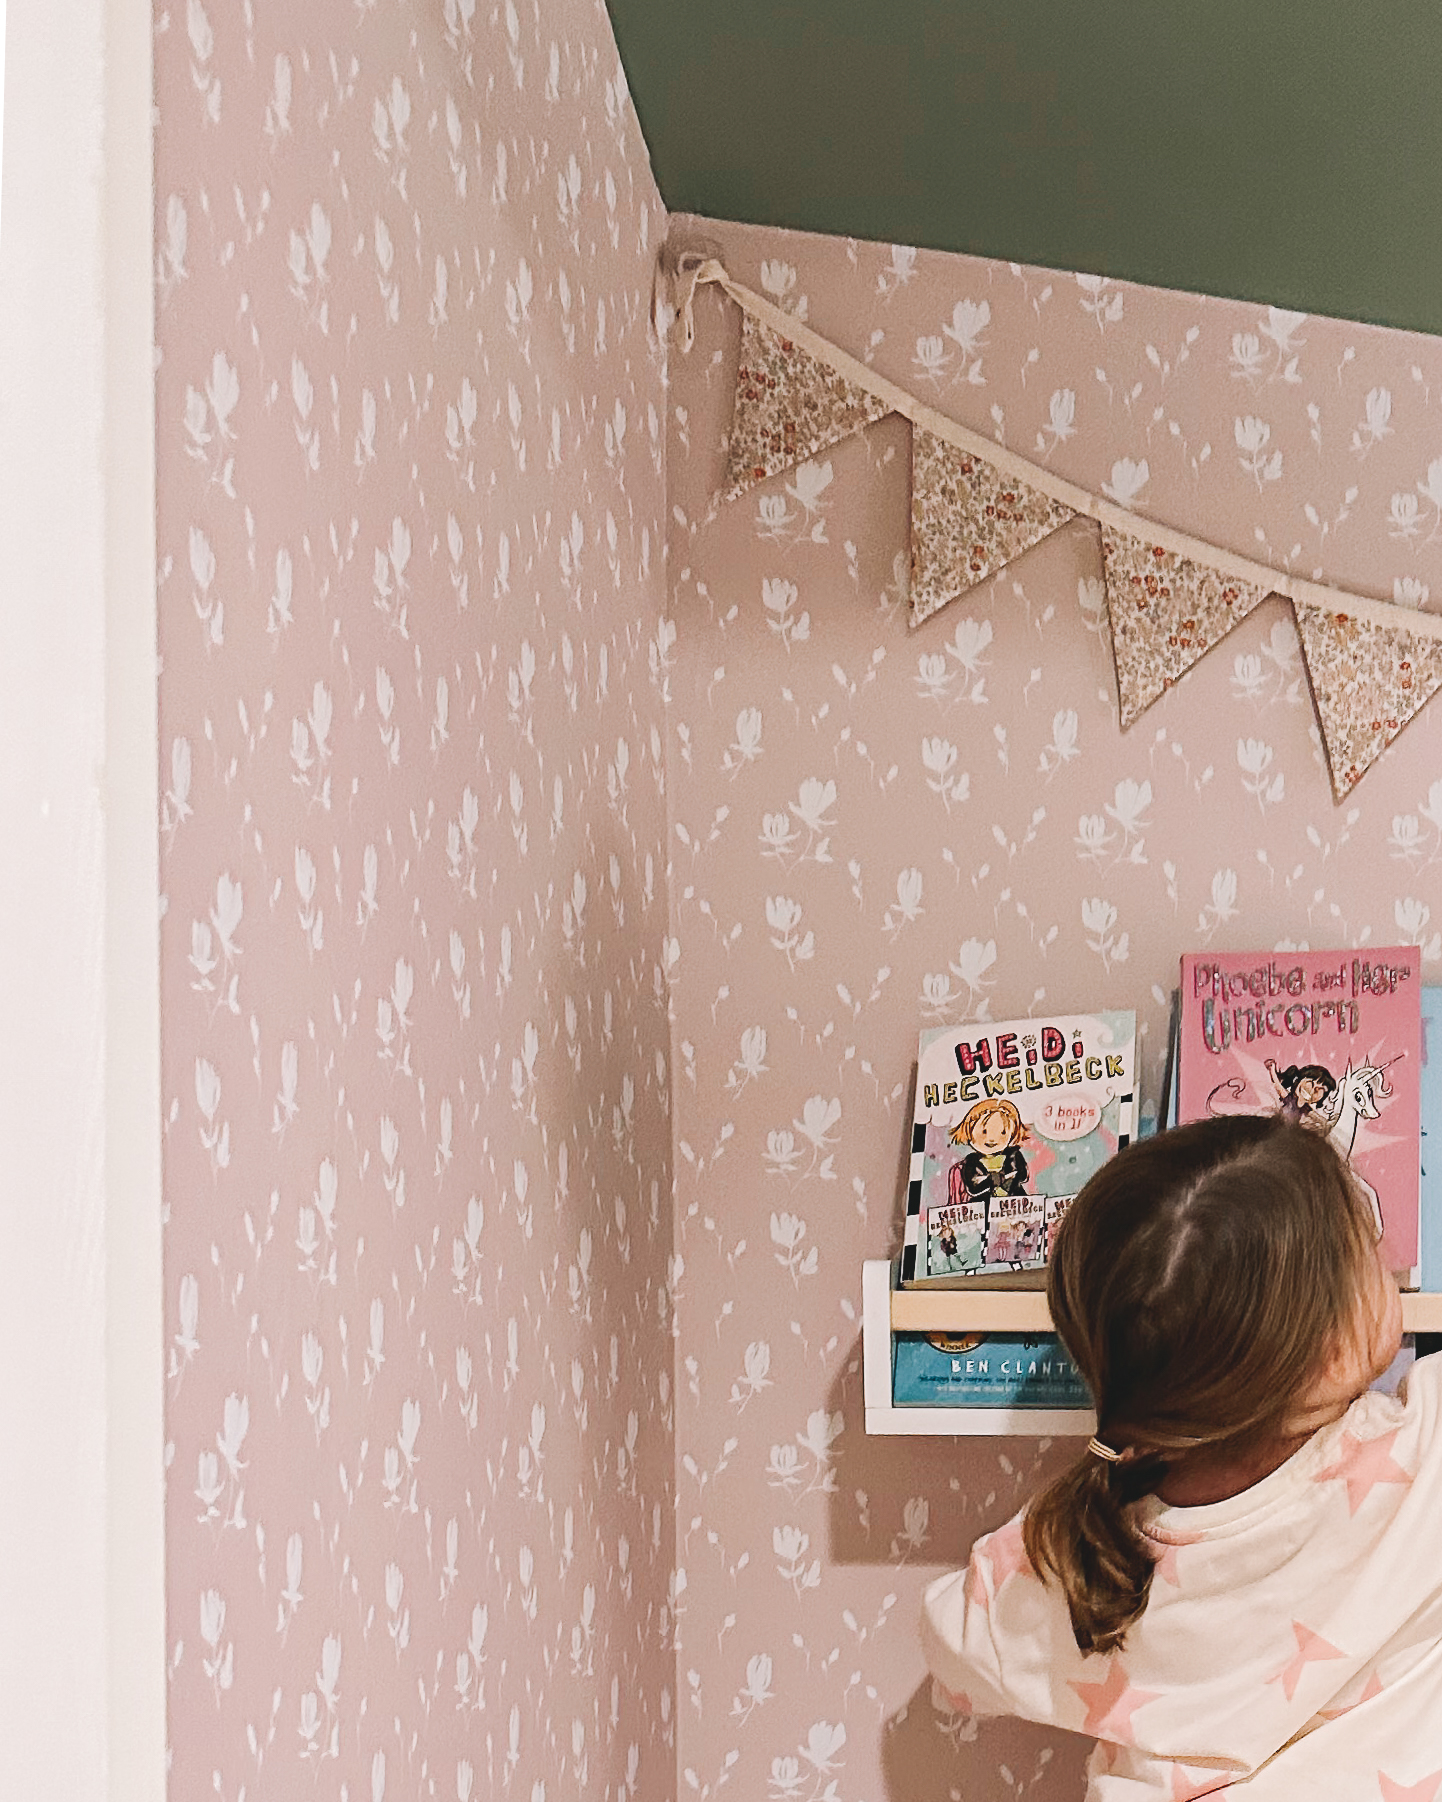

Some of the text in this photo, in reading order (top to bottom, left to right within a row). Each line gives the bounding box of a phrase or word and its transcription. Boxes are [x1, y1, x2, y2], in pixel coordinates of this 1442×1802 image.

[1194, 958, 1411, 1003] Phoebe and Her
[1202, 997, 1360, 1055] Unicorn
[924, 1055, 1125, 1107] HECKELBECK
[1045, 1105, 1095, 1117] 3 books
[1055, 1120, 1066, 1131] in
[951, 1359, 1080, 1375] BEN CLANTO
